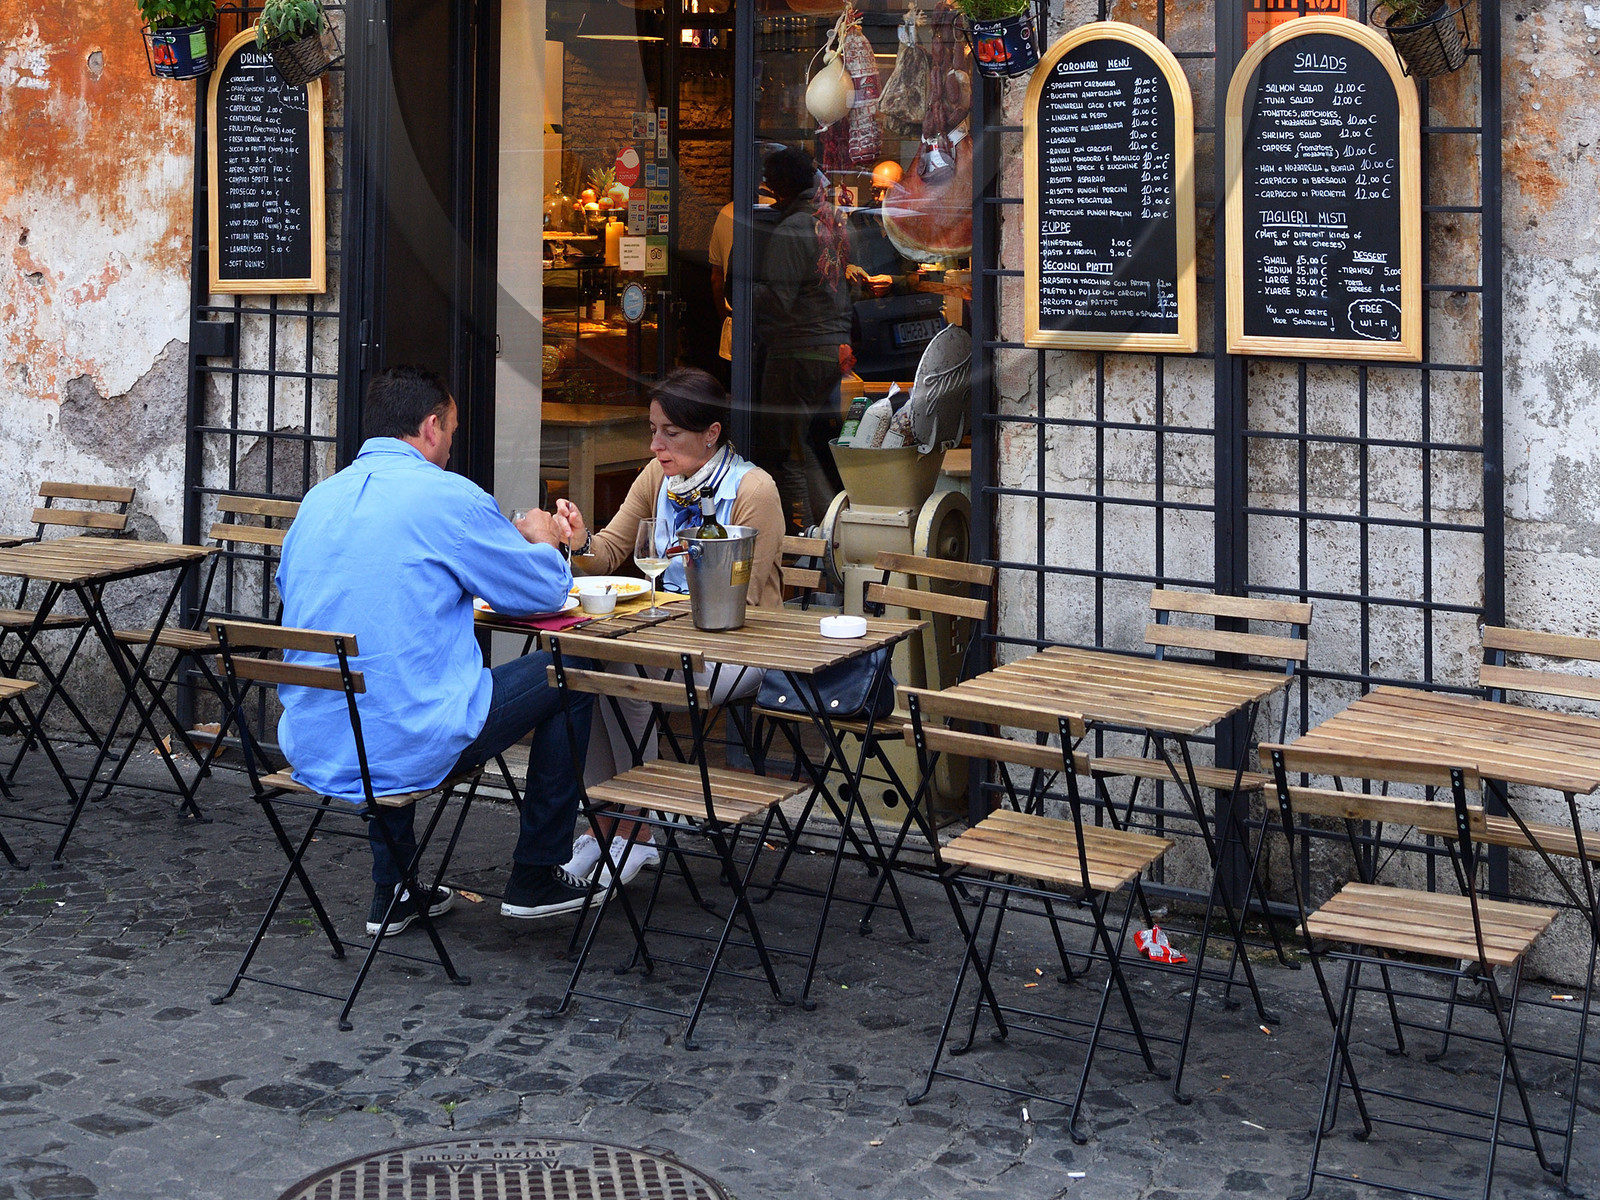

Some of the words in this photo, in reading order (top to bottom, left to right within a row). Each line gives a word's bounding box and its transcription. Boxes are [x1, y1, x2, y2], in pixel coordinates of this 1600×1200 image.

[240, 53, 274, 64] DRINKS
[1294, 52, 1347, 70] SALADS
[1057, 61, 1098, 72] CORONARI
[1050, 81, 1082, 90] SPAGHETTI
[1083, 80, 1116, 88] CARBONARA
[1265, 83, 1295, 93] SALMON
[1298, 84, 1324, 93] SALAD
[1050, 91, 1078, 99] BUCATINI
[1113, 100, 1127, 108] PEPE
[1264, 97, 1285, 105] TUNA
[1290, 97, 1314, 105] SALAD
[1051, 113, 1079, 121] LINGUINE
[1281, 119, 1317, 127] MOZZARELLA
[1320, 119, 1343, 127] SALAD
[1050, 125, 1079, 133] PENNETTE
[1050, 136, 1077, 144] LASAGNA
[1261, 131, 1295, 140] SHRIMPS
[1299, 131, 1322, 139] SALAD
[1049, 147, 1071, 155] RAVIOLI
[1087, 145, 1113, 153] CARCIOFI
[1261, 144, 1292, 152] CAPRESE
[1260, 165, 1275, 173] HAM
[1284, 164, 1323, 172] MOZZARELLA
[1330, 164, 1355, 173] BUFALA
[1050, 176, 1072, 184] RISOTTO
[1259, 177, 1298, 185] CARPACCIO
[1311, 177, 1347, 185] BRESAOLA
[1260, 190, 1298, 198] CARPACCIO
[1311, 190, 1346, 198] PORCHETTA
[1259, 210, 1308, 223] TAGLIERI
[1318, 212, 1347, 223] MISTI
[1041, 221, 1071, 232] ZUPPE
[1263, 255, 1288, 265] SMALL
[1353, 251, 1388, 260] DESSERT
[1042, 261, 1080, 271] SECONDI
[1086, 262, 1113, 272] PIATTI
[1264, 266, 1292, 275] MEDIUM
[1042, 277, 1072, 285] BRASATO
[1080, 278, 1111, 286] TACCHINO
[1113, 279, 1127, 287] CON
[1265, 276, 1289, 284] LARGE
[1264, 287, 1291, 296] XLARGE
[1074, 299, 1088, 307] CON
[1090, 298, 1119, 306] PATATE
[1042, 307, 1065, 316] PETTO
[1067, 308, 1075, 316] DI
[1094, 309, 1107, 317] CON
[1110, 309, 1134, 317] PATATE
[1359, 304, 1383, 314] FREE
